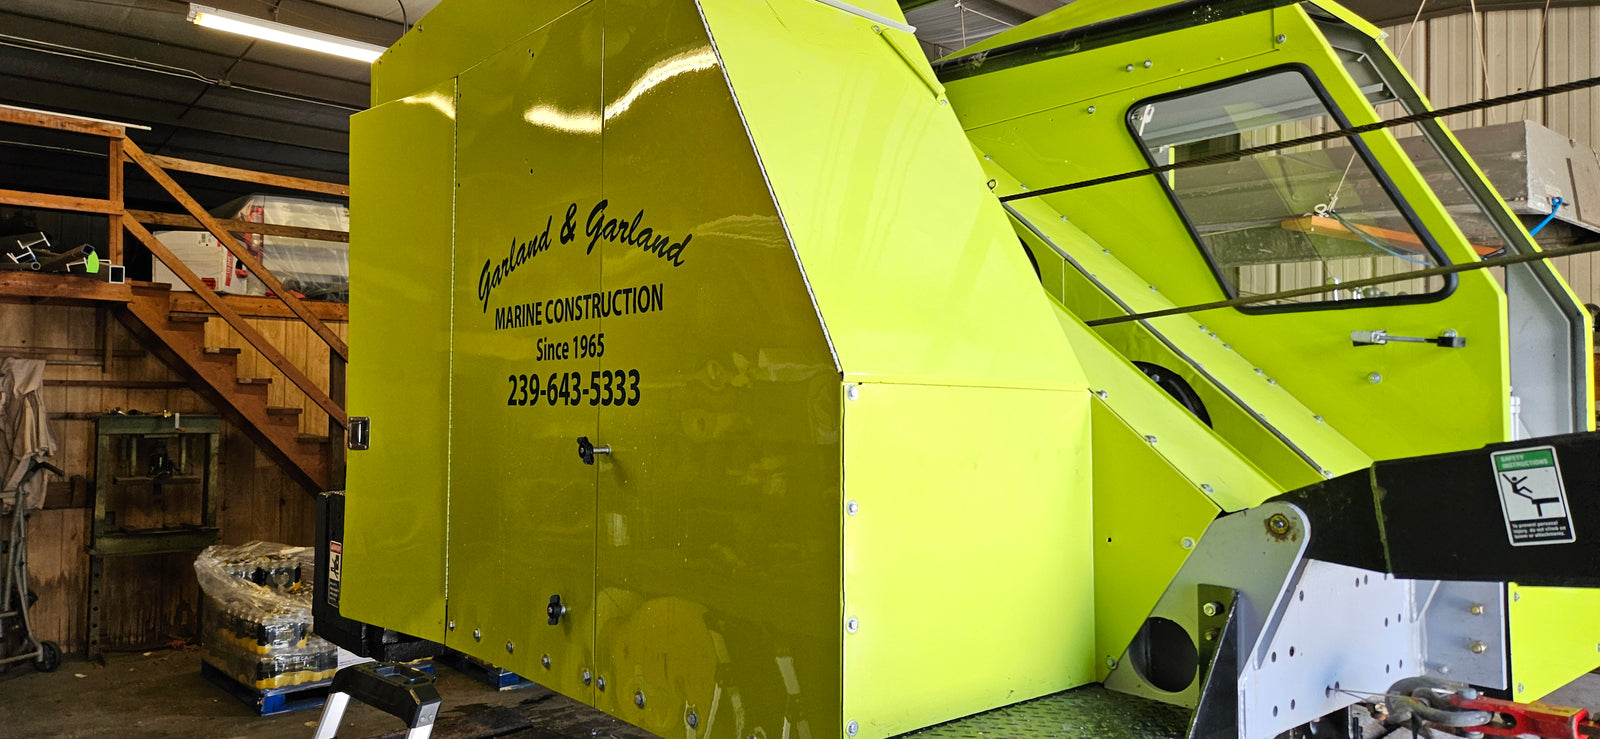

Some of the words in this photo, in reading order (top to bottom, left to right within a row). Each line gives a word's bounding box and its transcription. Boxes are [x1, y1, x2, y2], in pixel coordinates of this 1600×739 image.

[478, 214, 553, 314] Garland
[559, 202, 578, 245] &
[585, 198, 693, 268] Garland
[494, 301, 543, 331] MARINE
[544, 283, 664, 325] CONSTRUCTION
[536, 336, 570, 362] Since
[572, 332, 605, 359] 1965
[507, 368, 641, 407] 239-643-5333
[1500, 454, 1524, 463] SAFETY
[1501, 458, 1548, 470] INSTRUCTIONS
